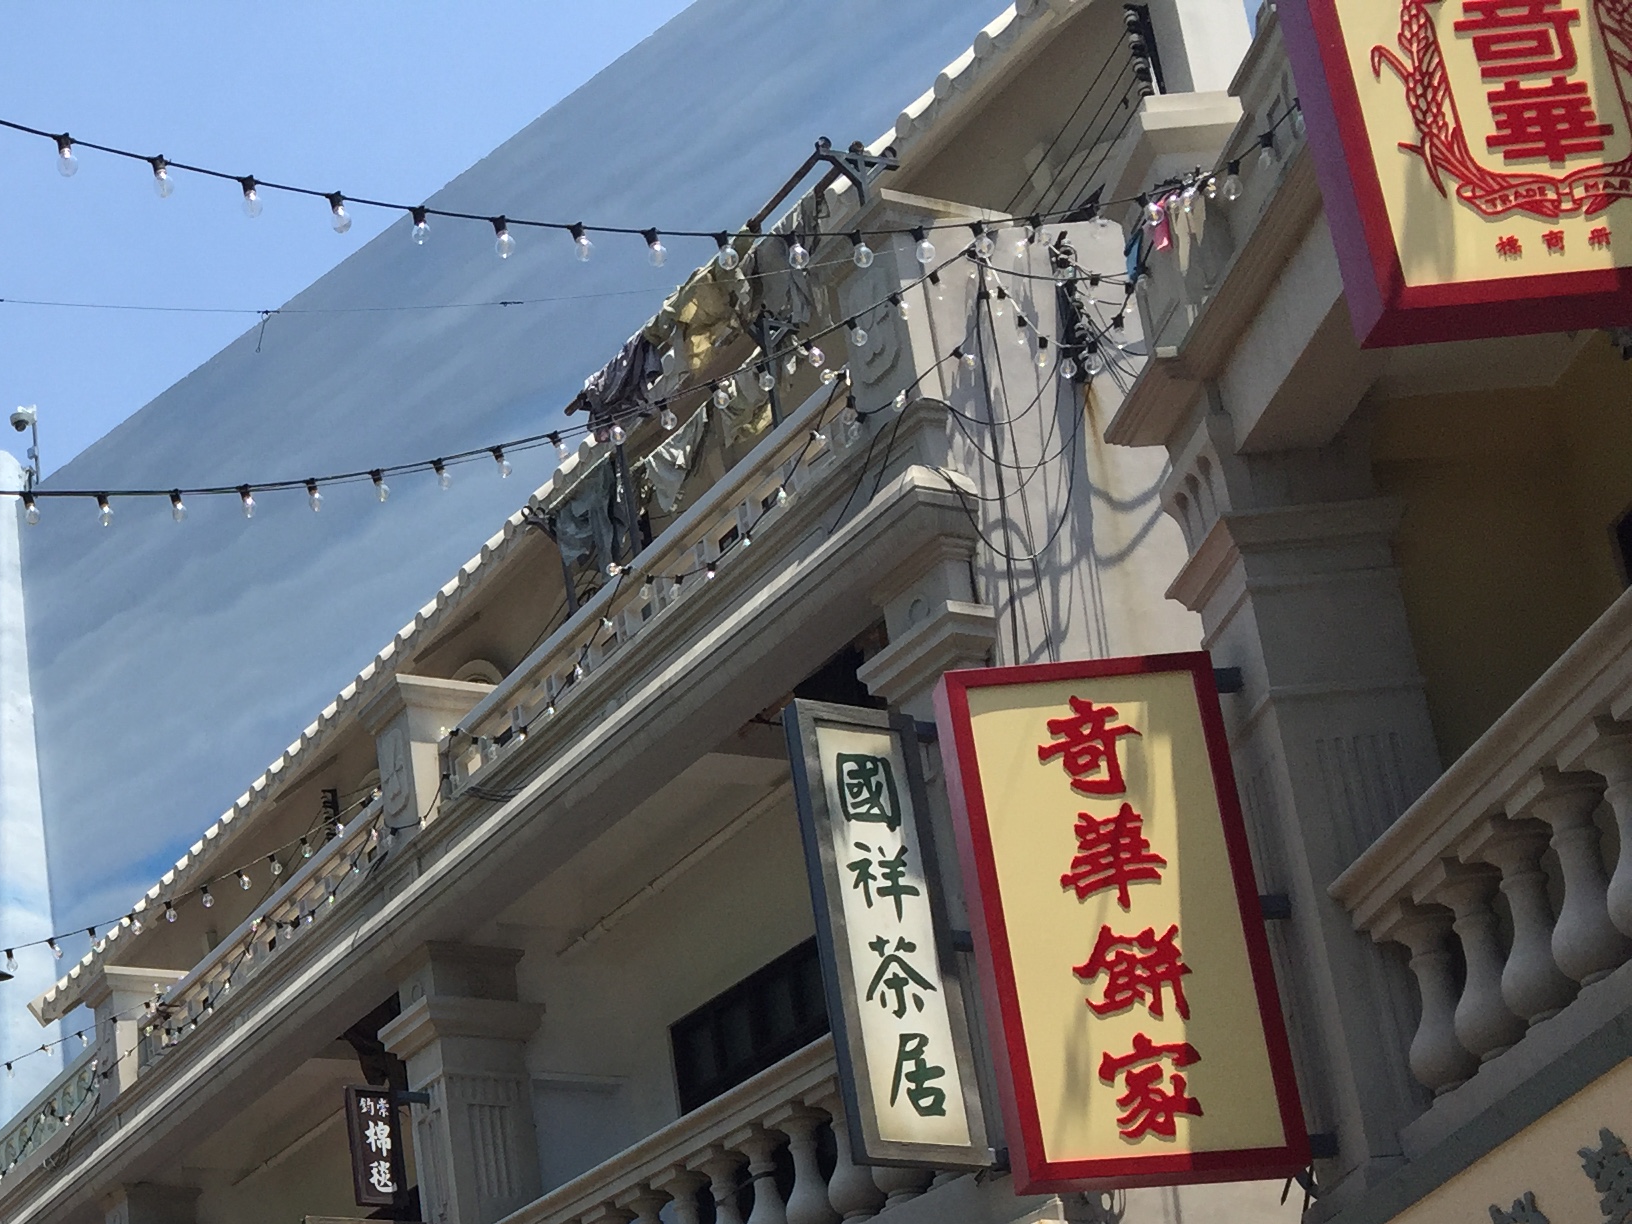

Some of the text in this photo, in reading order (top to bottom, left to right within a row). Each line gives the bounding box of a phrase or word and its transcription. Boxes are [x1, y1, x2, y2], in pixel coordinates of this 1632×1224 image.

[1484, 186, 1547, 209] TRADE
[835, 752, 947, 1118] 國祥茶居
[1038, 695, 1204, 1141] 奇華餅家
